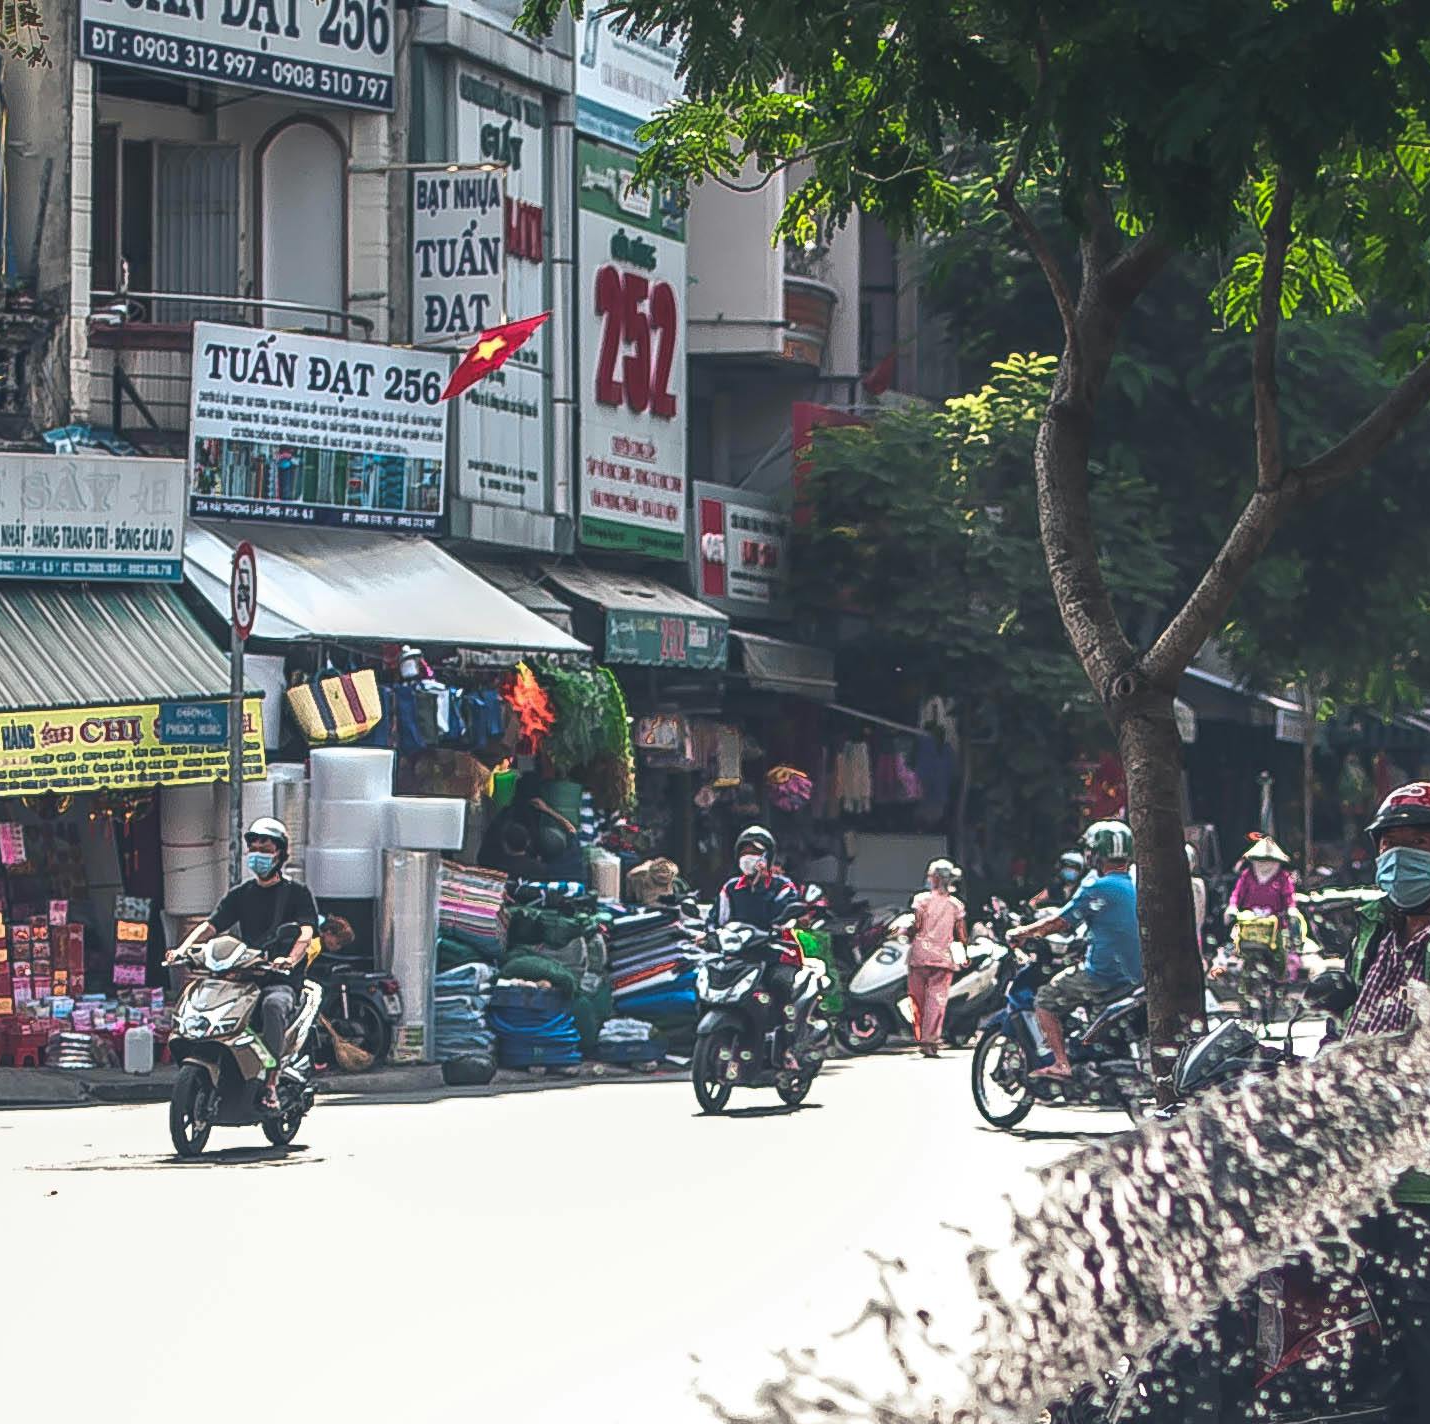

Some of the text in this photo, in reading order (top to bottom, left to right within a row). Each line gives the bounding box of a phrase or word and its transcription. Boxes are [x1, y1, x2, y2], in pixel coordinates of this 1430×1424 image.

[92, 27, 116, 53] ĐT
[133, 35, 179, 64] 0903
[184, 44, 220, 72] 312
[224, 51, 256, 77] 997
[272, 61, 315, 90] 0908
[320, 71, 353, 96] 510
[357, 78, 388, 102] 797
[417, 178, 450, 217] BẠT
[415, 219, 501, 278] TUẤN
[204, 334, 298, 388] TUẤN
[307, 357, 375, 403] ĐẠT
[384, 366, 442, 406] 256
[594, 264, 677, 420] 252
[62, 525, 93, 551] TRANG
[79, 715, 144, 746] CHỊ
